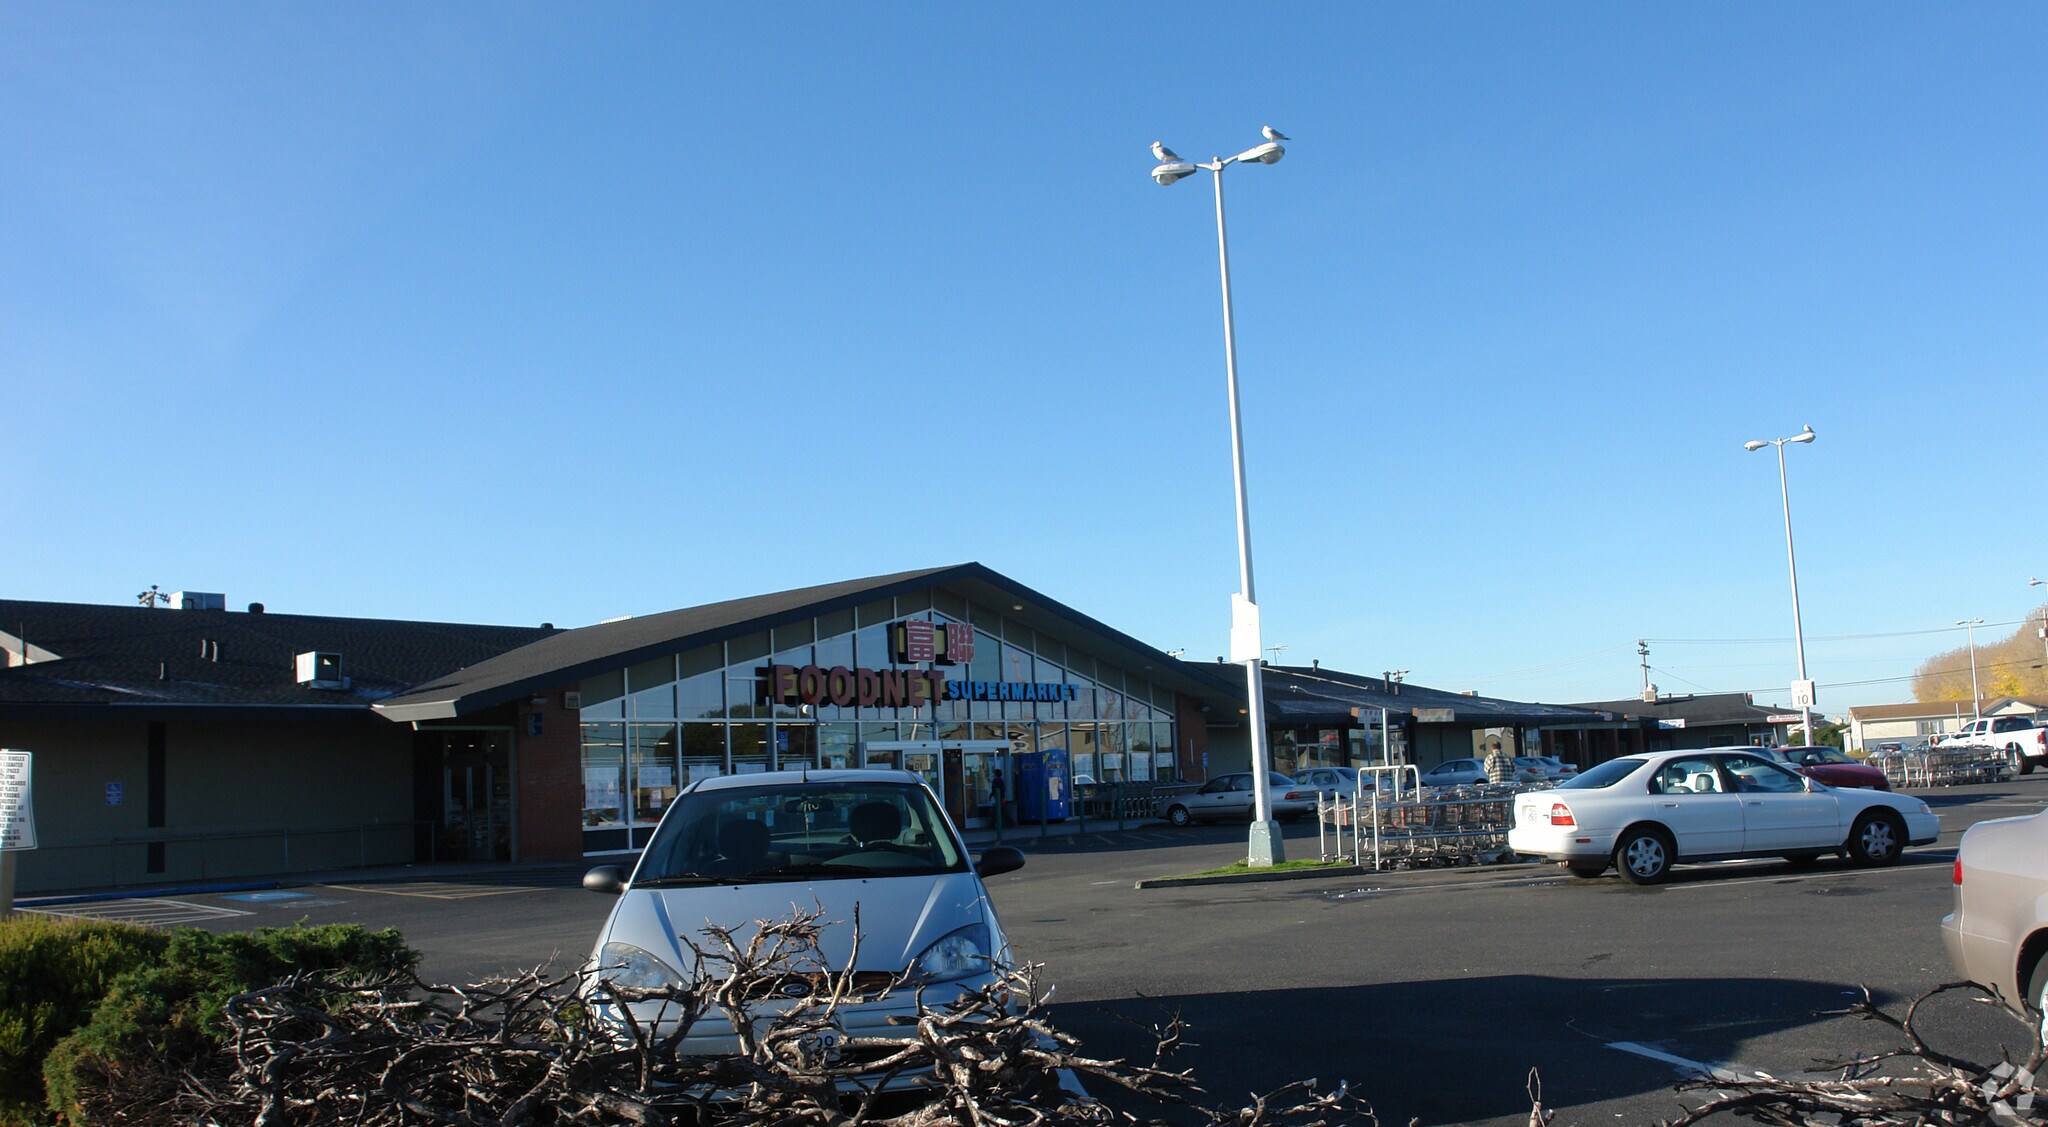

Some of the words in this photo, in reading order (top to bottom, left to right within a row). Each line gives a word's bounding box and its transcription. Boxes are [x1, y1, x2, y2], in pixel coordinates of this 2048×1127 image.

[772, 664, 945, 707] FOODNET
[949, 679, 1080, 701] SUPERMARKET
[1797, 694, 1809, 705] 10
